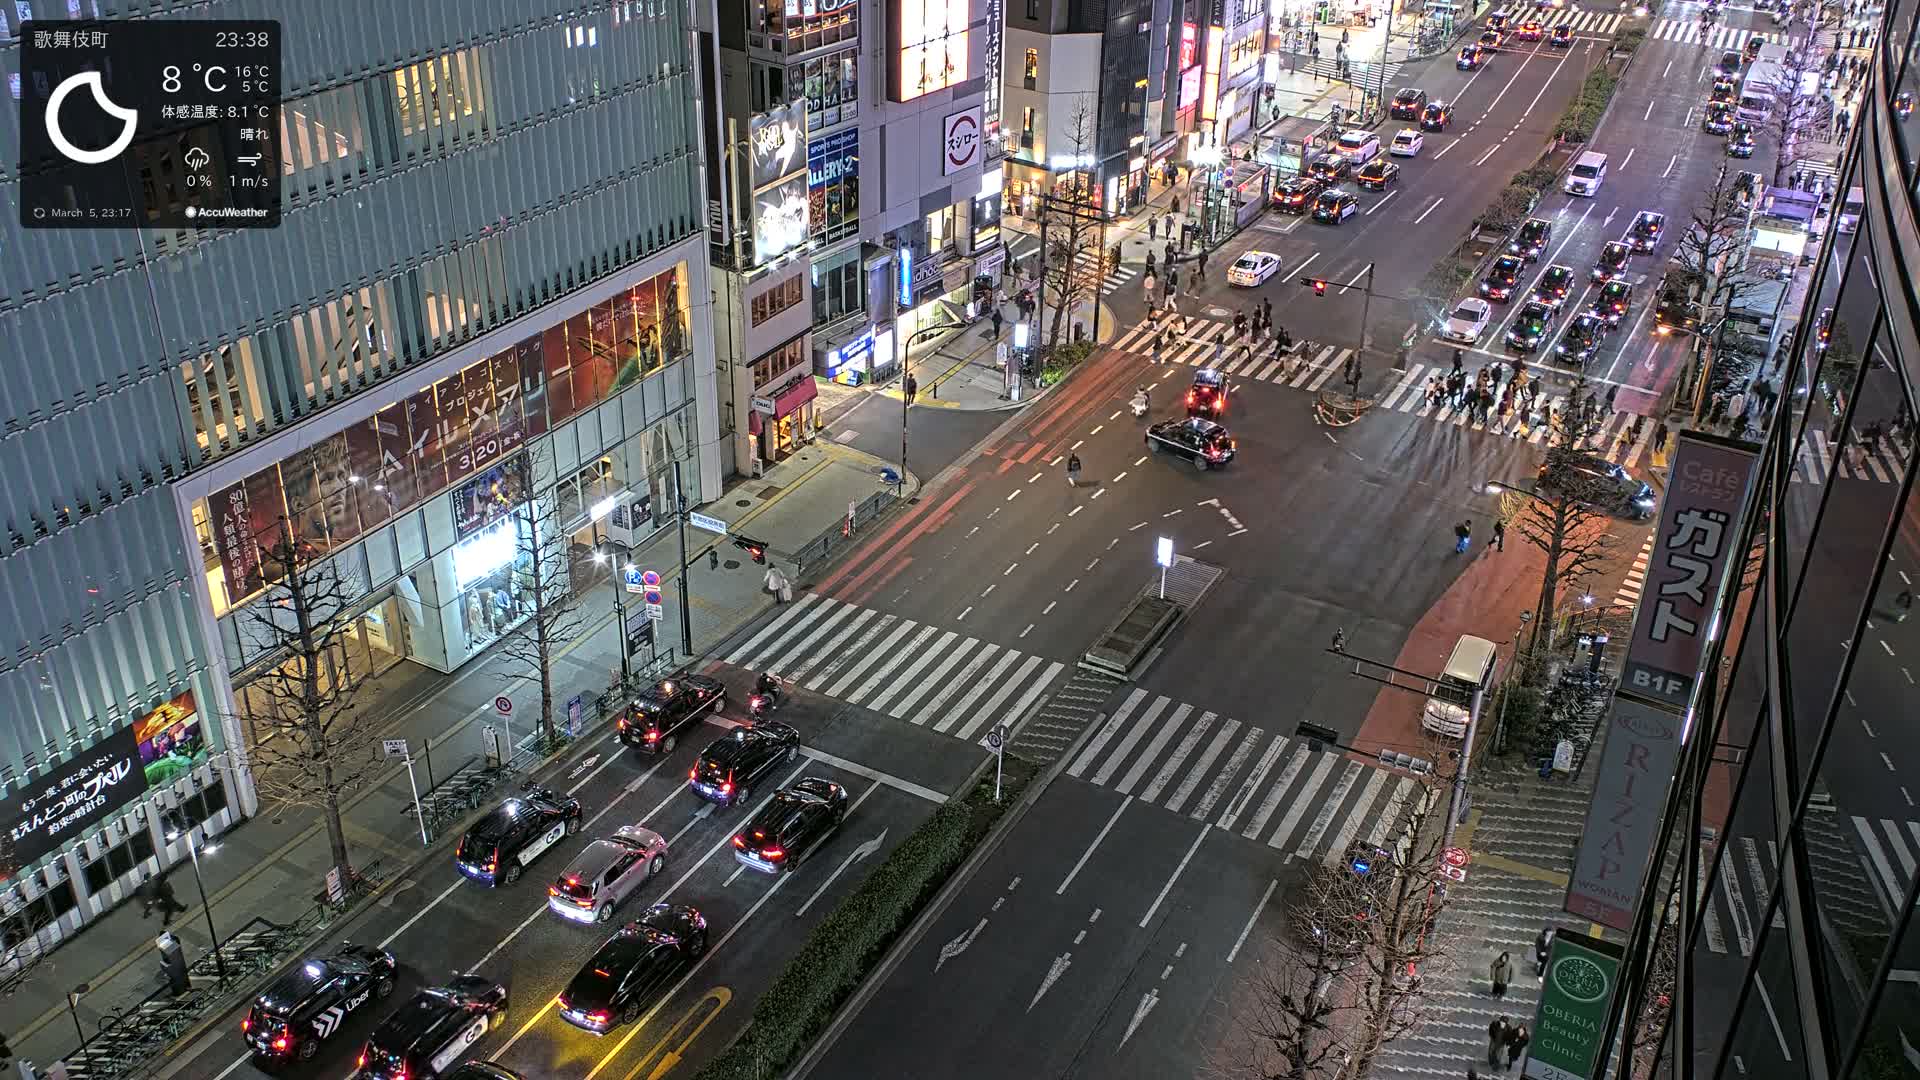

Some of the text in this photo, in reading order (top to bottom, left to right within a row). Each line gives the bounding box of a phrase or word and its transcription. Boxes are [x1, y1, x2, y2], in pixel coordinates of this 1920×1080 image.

[947, 133, 978, 152] スシロー
[709, 199, 722, 232] MUJI
[445, 377, 504, 412] プロジェクト
[1650, 508, 1729, 642] ガスト
[1632, 668, 1683, 695] B1F
[22, 754, 113, 812] もう一度、君に会いたい
[48, 795, 106, 836] 約束の時計台
[1597, 742, 1649, 880] RIZAP
[1578, 879, 1634, 903] WOMAN
[346, 989, 369, 1012] Uber
[1543, 1004, 1597, 1033] OBERIA
[1543, 1020, 1590, 1046] Beauty
[1542, 1039, 1582, 1061] Clinic
